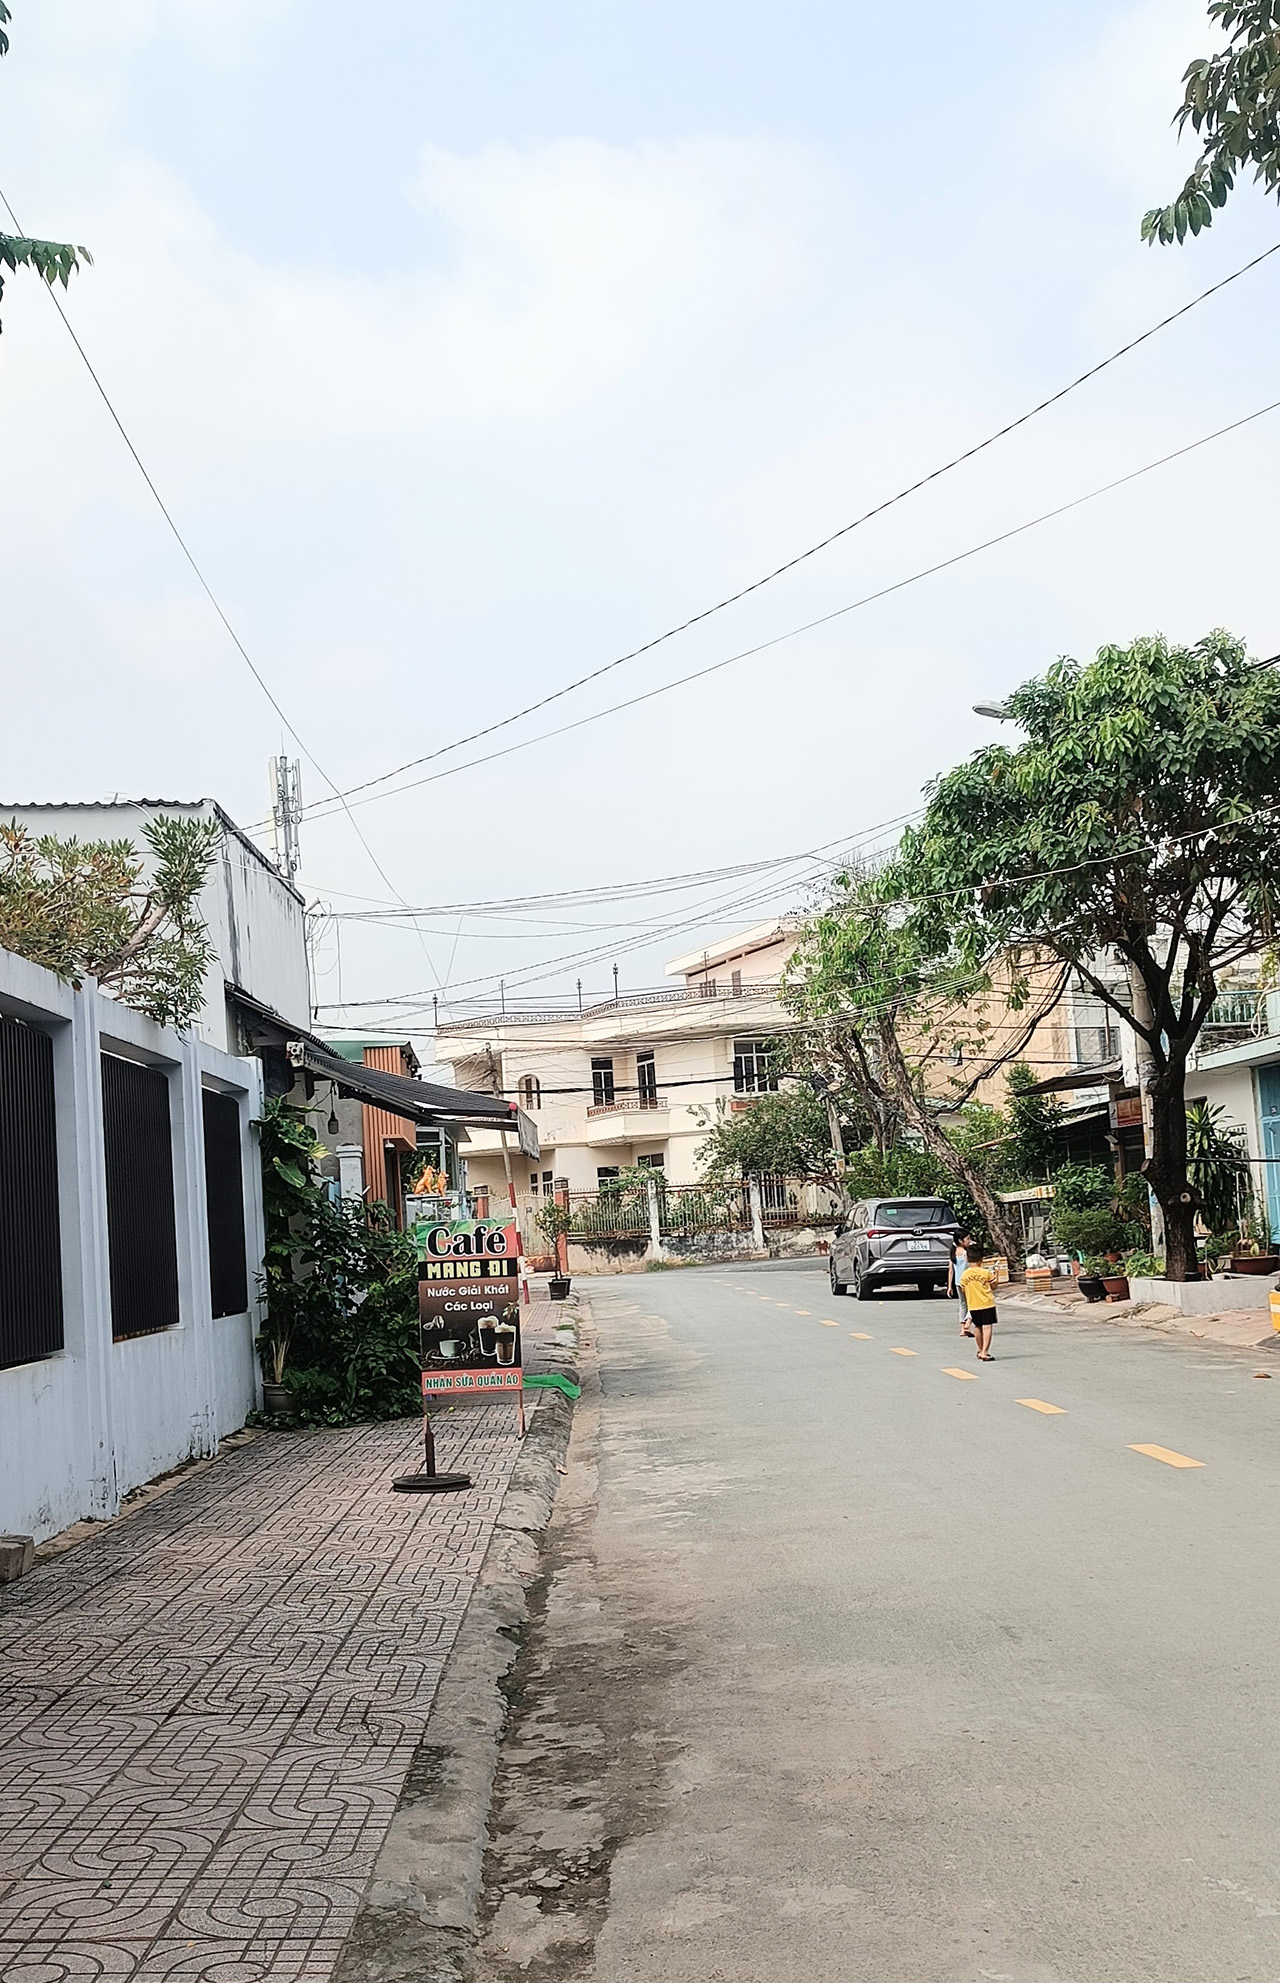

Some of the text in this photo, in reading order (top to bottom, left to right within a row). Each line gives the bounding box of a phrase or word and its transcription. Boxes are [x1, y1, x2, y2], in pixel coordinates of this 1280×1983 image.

[427, 1225, 506, 1257] Café
[427, 1260, 508, 1279] MANG ĐI
[427, 1283, 509, 1298] Nước Giải Khát
[444, 1300, 493, 1312] Các Loại
[425, 1375, 452, 1391] NHẬN
[506, 1372, 519, 1385] ÁO
